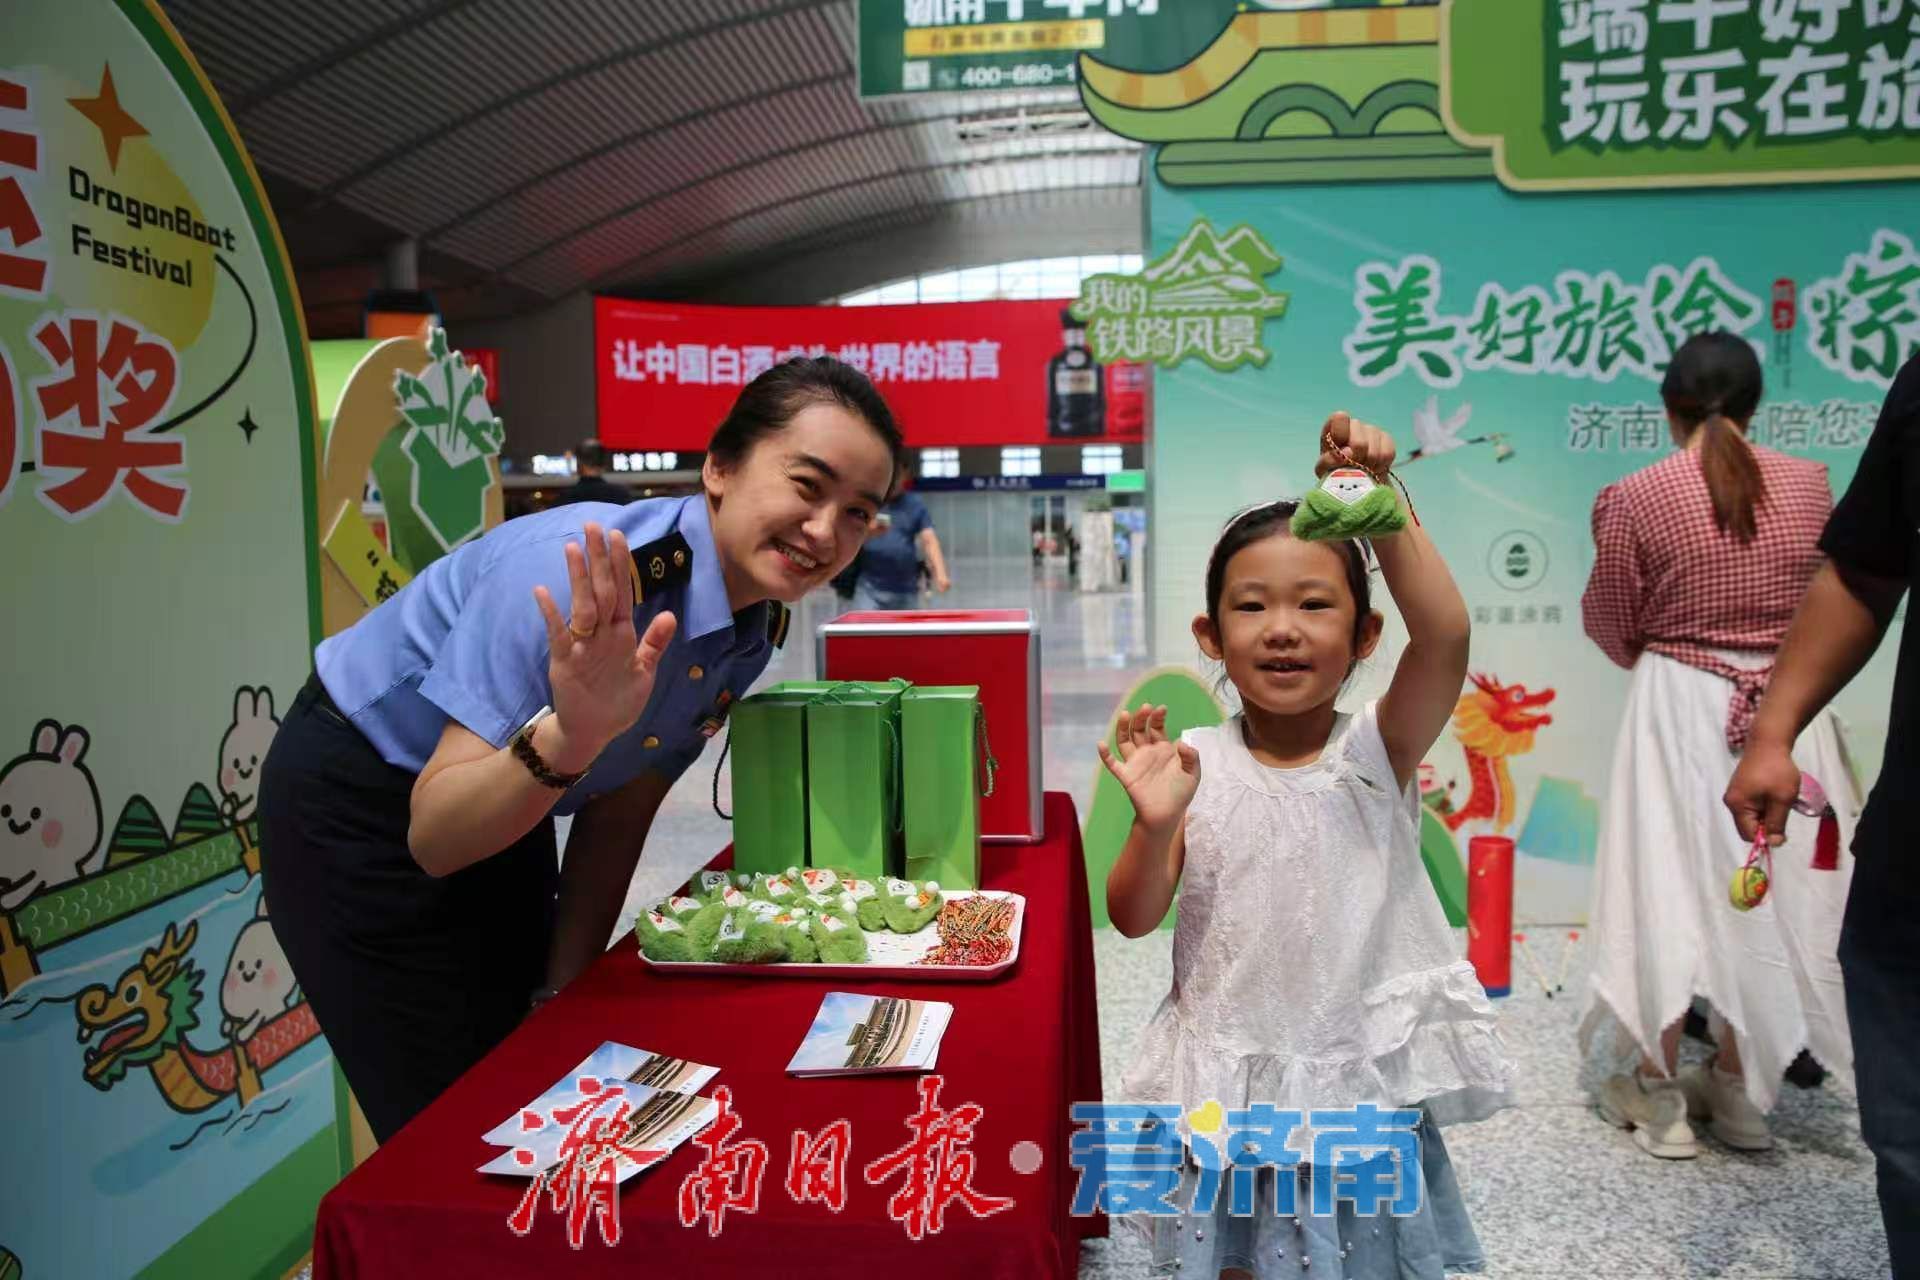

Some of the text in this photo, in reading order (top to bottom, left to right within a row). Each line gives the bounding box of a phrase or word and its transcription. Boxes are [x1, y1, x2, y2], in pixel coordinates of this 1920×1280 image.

[72, 224, 192, 288] Festival
[1076, 279, 1147, 315] 我的
[613, 339, 1001, 384] 让中国白酒世界的语言
[1094, 315, 1265, 363] 铁路风景
[0, 318, 188, 517] 奖
